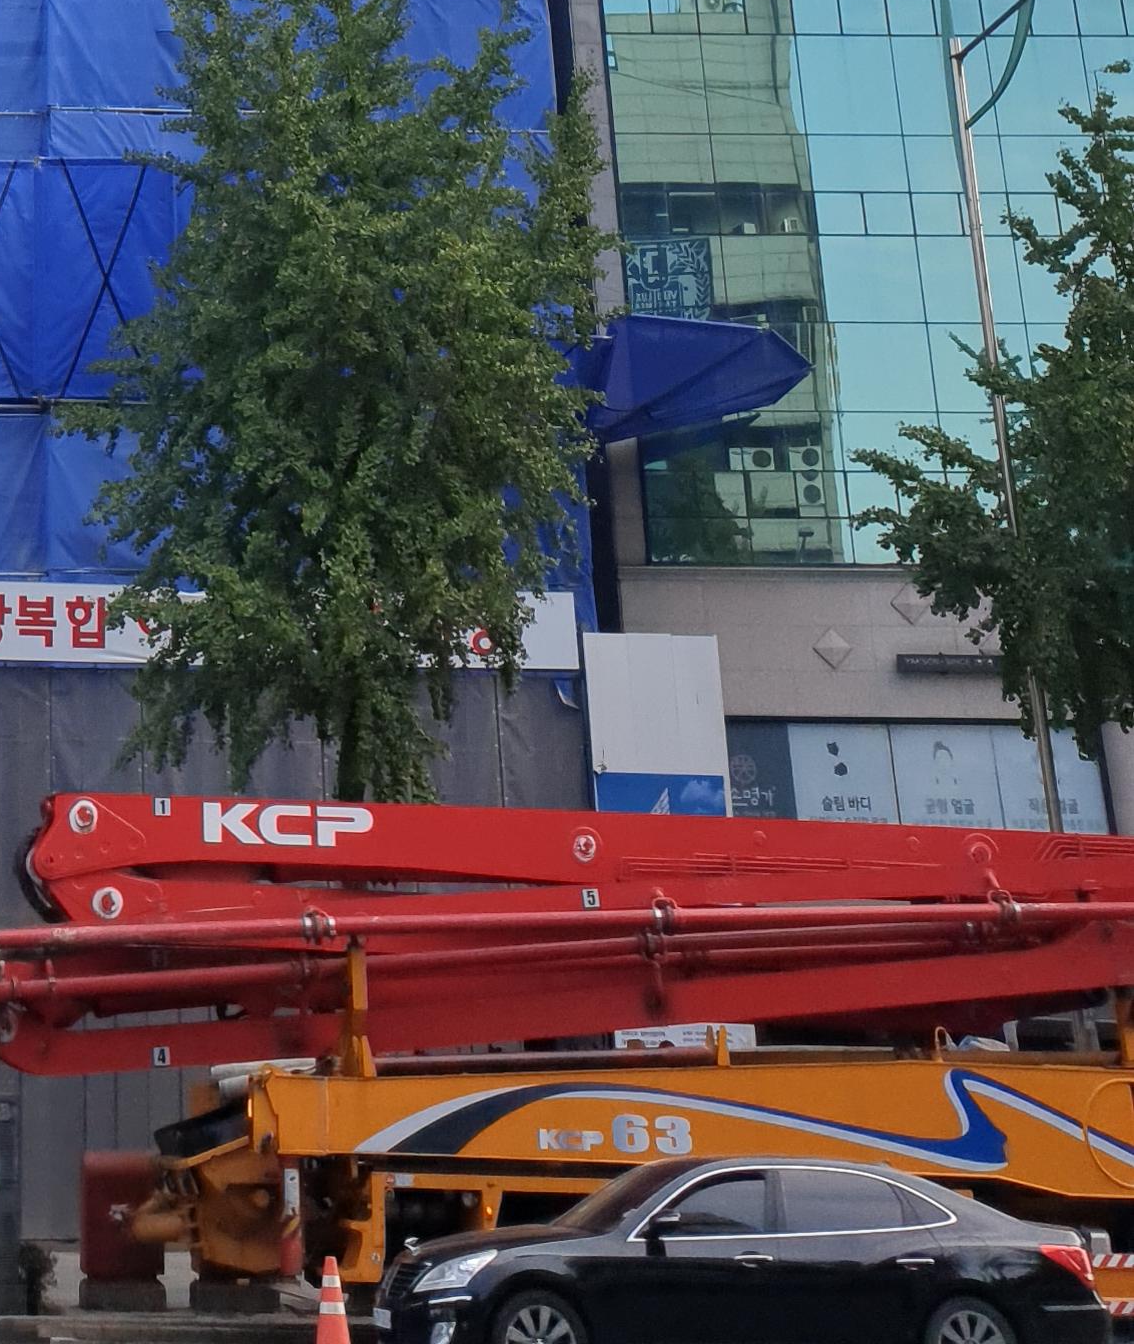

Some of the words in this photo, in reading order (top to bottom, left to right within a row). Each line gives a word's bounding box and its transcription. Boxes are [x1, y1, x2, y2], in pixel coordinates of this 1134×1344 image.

[848, 796, 872, 811] 바디
[202, 801, 375, 847] KCP
[586, 890, 596, 906] 5
[157, 1048, 166, 1064] 4
[538, 1127, 605, 1152] KCP
[611, 1113, 693, 1155] 63
